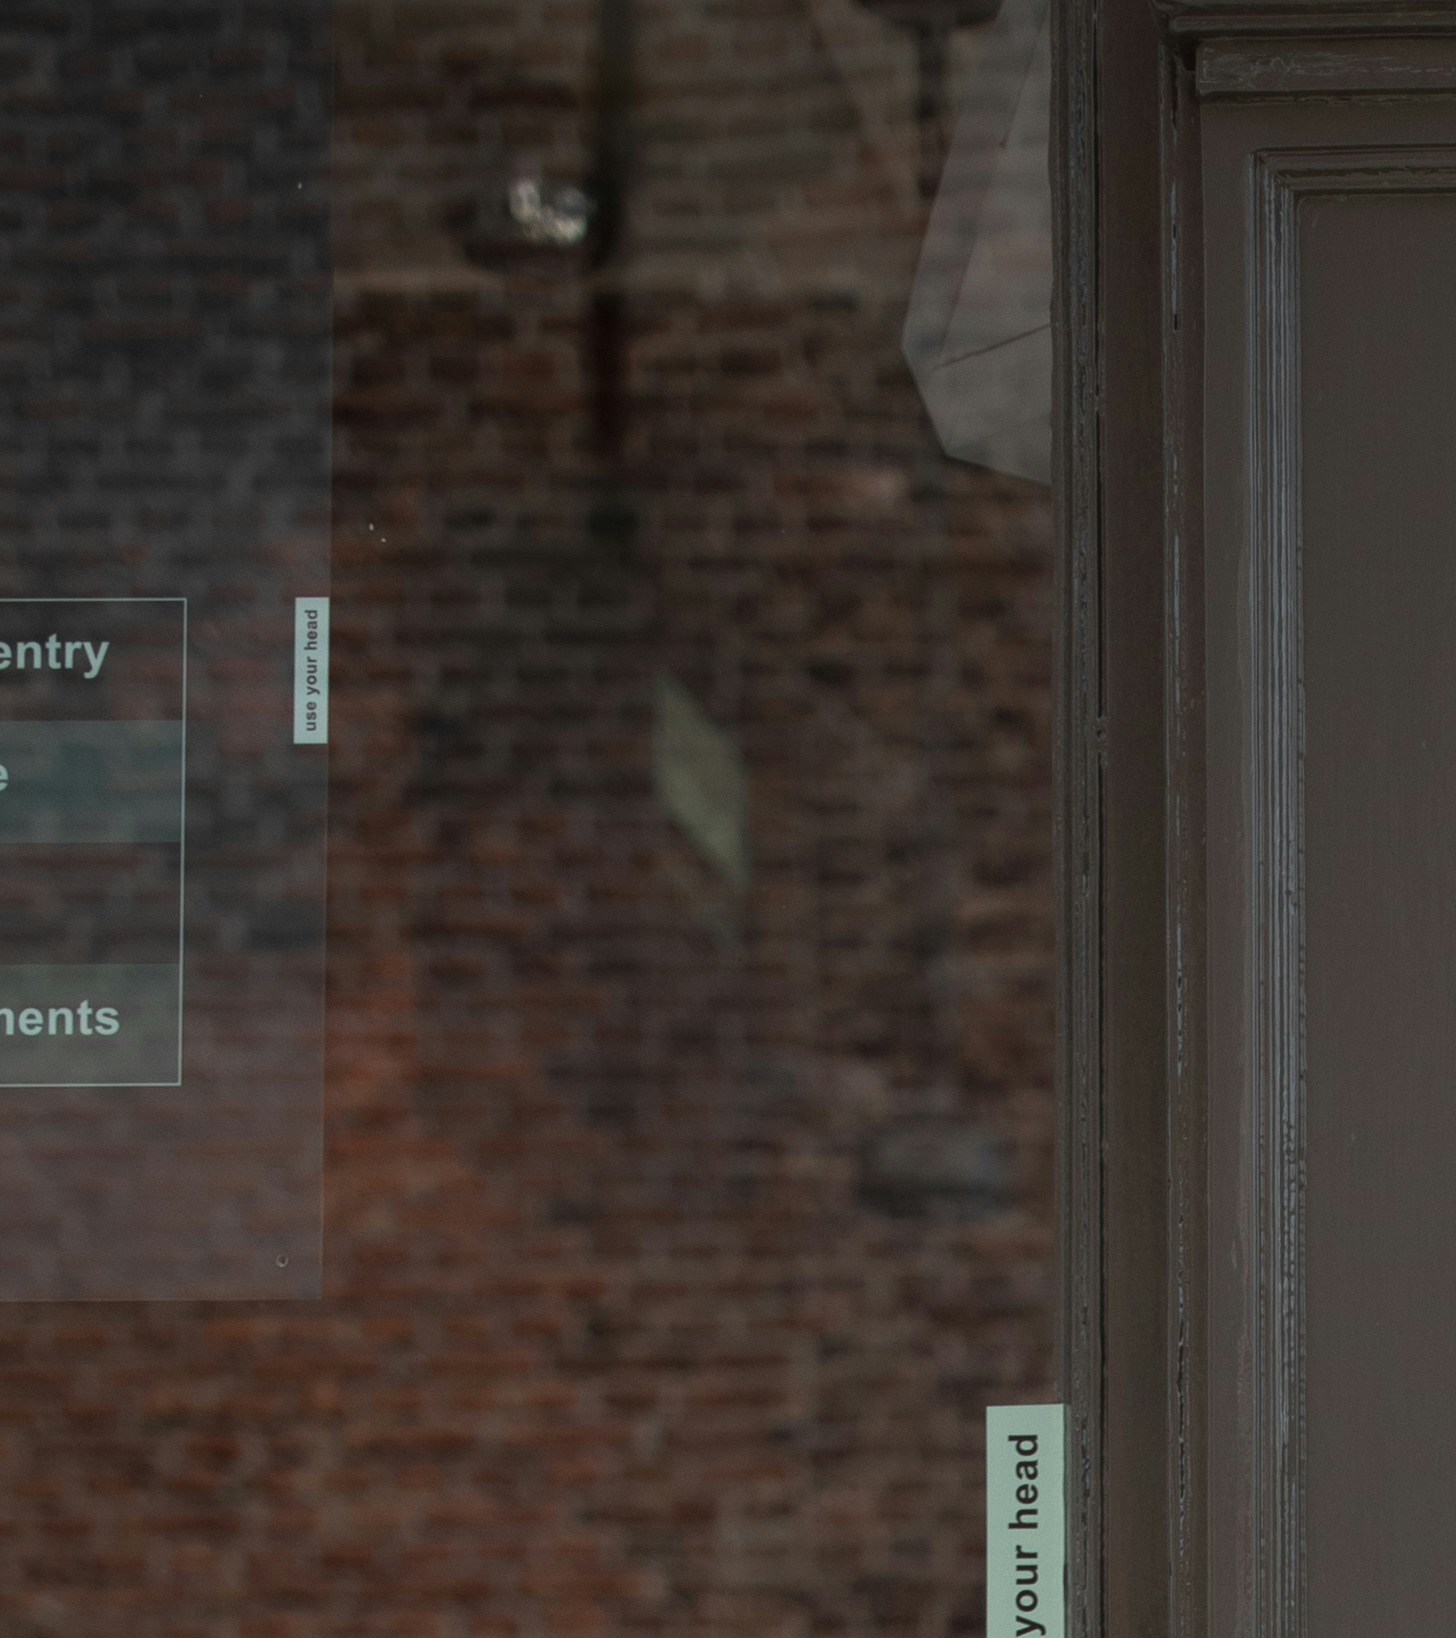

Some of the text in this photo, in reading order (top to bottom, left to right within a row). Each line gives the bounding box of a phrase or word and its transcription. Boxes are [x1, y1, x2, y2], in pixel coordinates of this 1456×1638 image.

[303, 609, 321, 732] use your head
[1007, 1434, 1039, 1530] head
[1015, 1544, 1047, 1637] your
